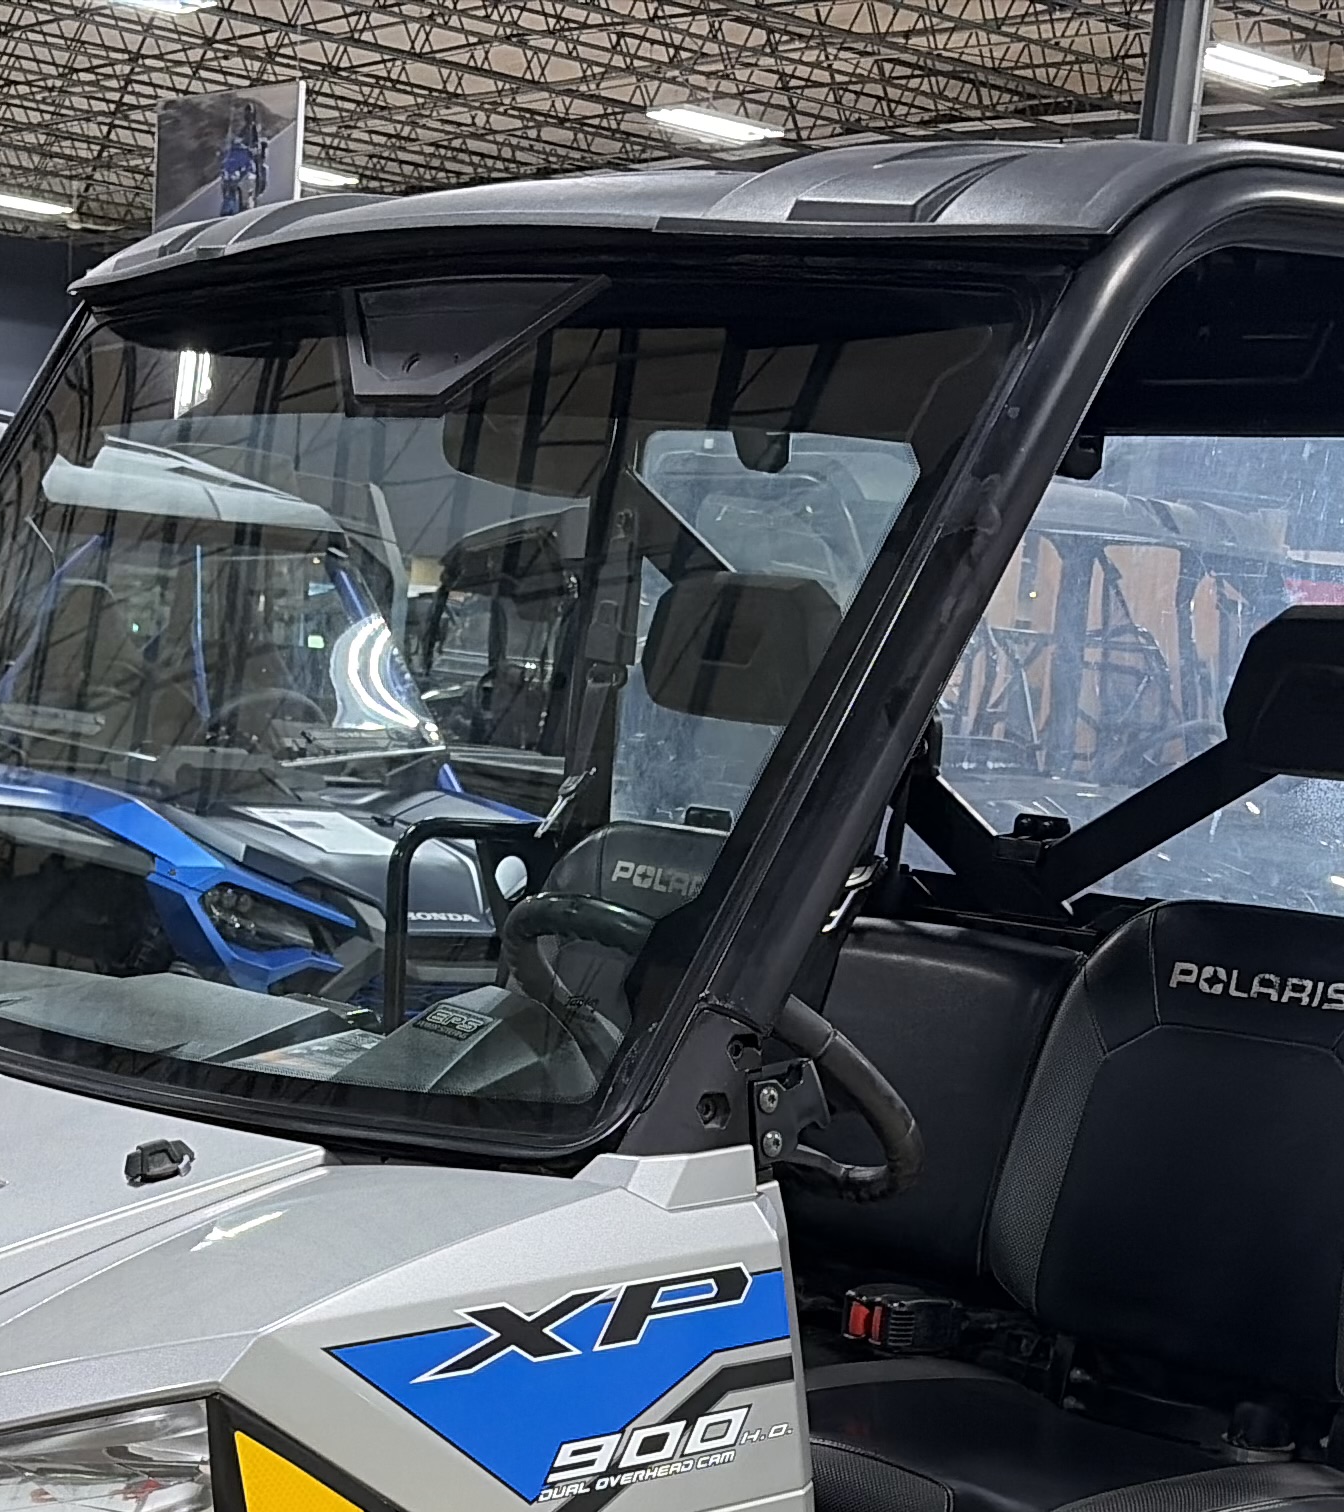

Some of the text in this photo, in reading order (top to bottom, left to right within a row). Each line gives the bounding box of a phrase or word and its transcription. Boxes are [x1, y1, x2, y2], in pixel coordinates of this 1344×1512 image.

[426, 1009, 485, 1033] EPS
[409, 1261, 754, 1385] XP
[538, 1450, 735, 1503] DUAL OVERHEAD CAM
[547, 1404, 794, 1483] 900 H.O.
